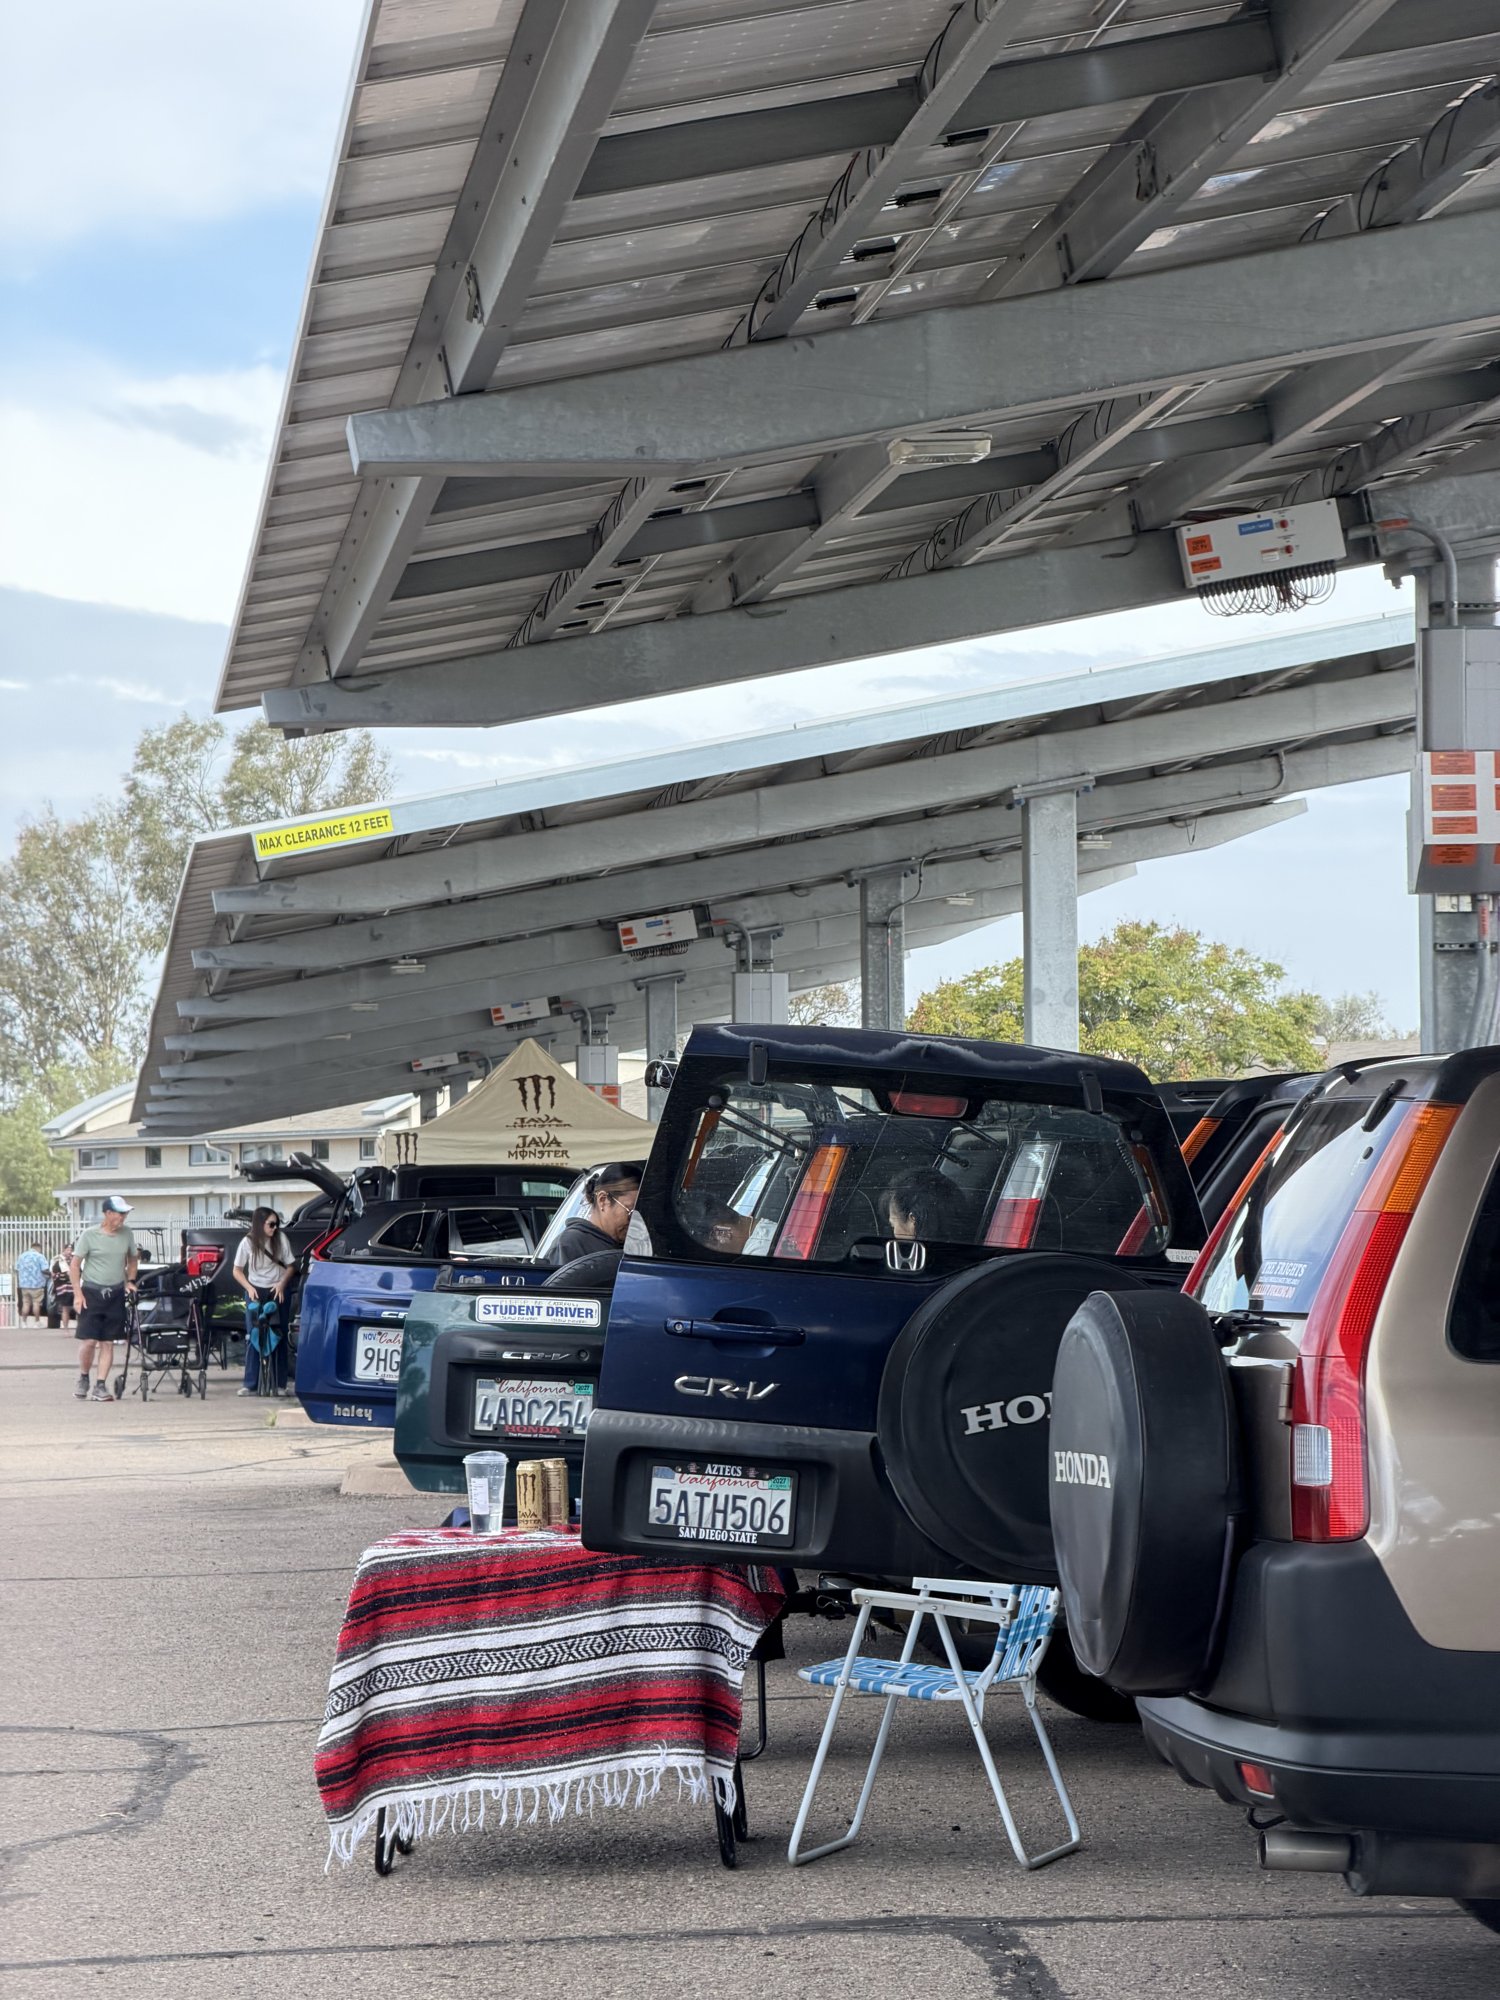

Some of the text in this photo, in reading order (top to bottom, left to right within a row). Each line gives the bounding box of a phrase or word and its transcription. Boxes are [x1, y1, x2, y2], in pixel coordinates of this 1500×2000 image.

[259, 815, 389, 852] MAX CLEARANCE 12 FEET
[513, 1114, 564, 1125] JAVA
[515, 1130, 563, 1149] JAVA
[507, 1148, 571, 1160] MONSTER
[482, 1304, 543, 1317] STUDENT
[546, 1306, 594, 1319] DRIVER
[363, 1332, 402, 1348] NOV Cali
[501, 1351, 573, 1360] CR-V
[498, 1379, 567, 1398] California
[674, 1375, 782, 1401] CR-V
[333, 1404, 373, 1421] haley
[478, 1395, 587, 1429] 4ARC254
[503, 1424, 562, 1435] HONDA
[705, 1463, 742, 1477] AZTECS
[1054, 1450, 1111, 1489] HONDA
[678, 1473, 766, 1492] California
[655, 1488, 787, 1534] 5ATH506
[678, 1526, 758, 1544] SAN DIEGO STATE
